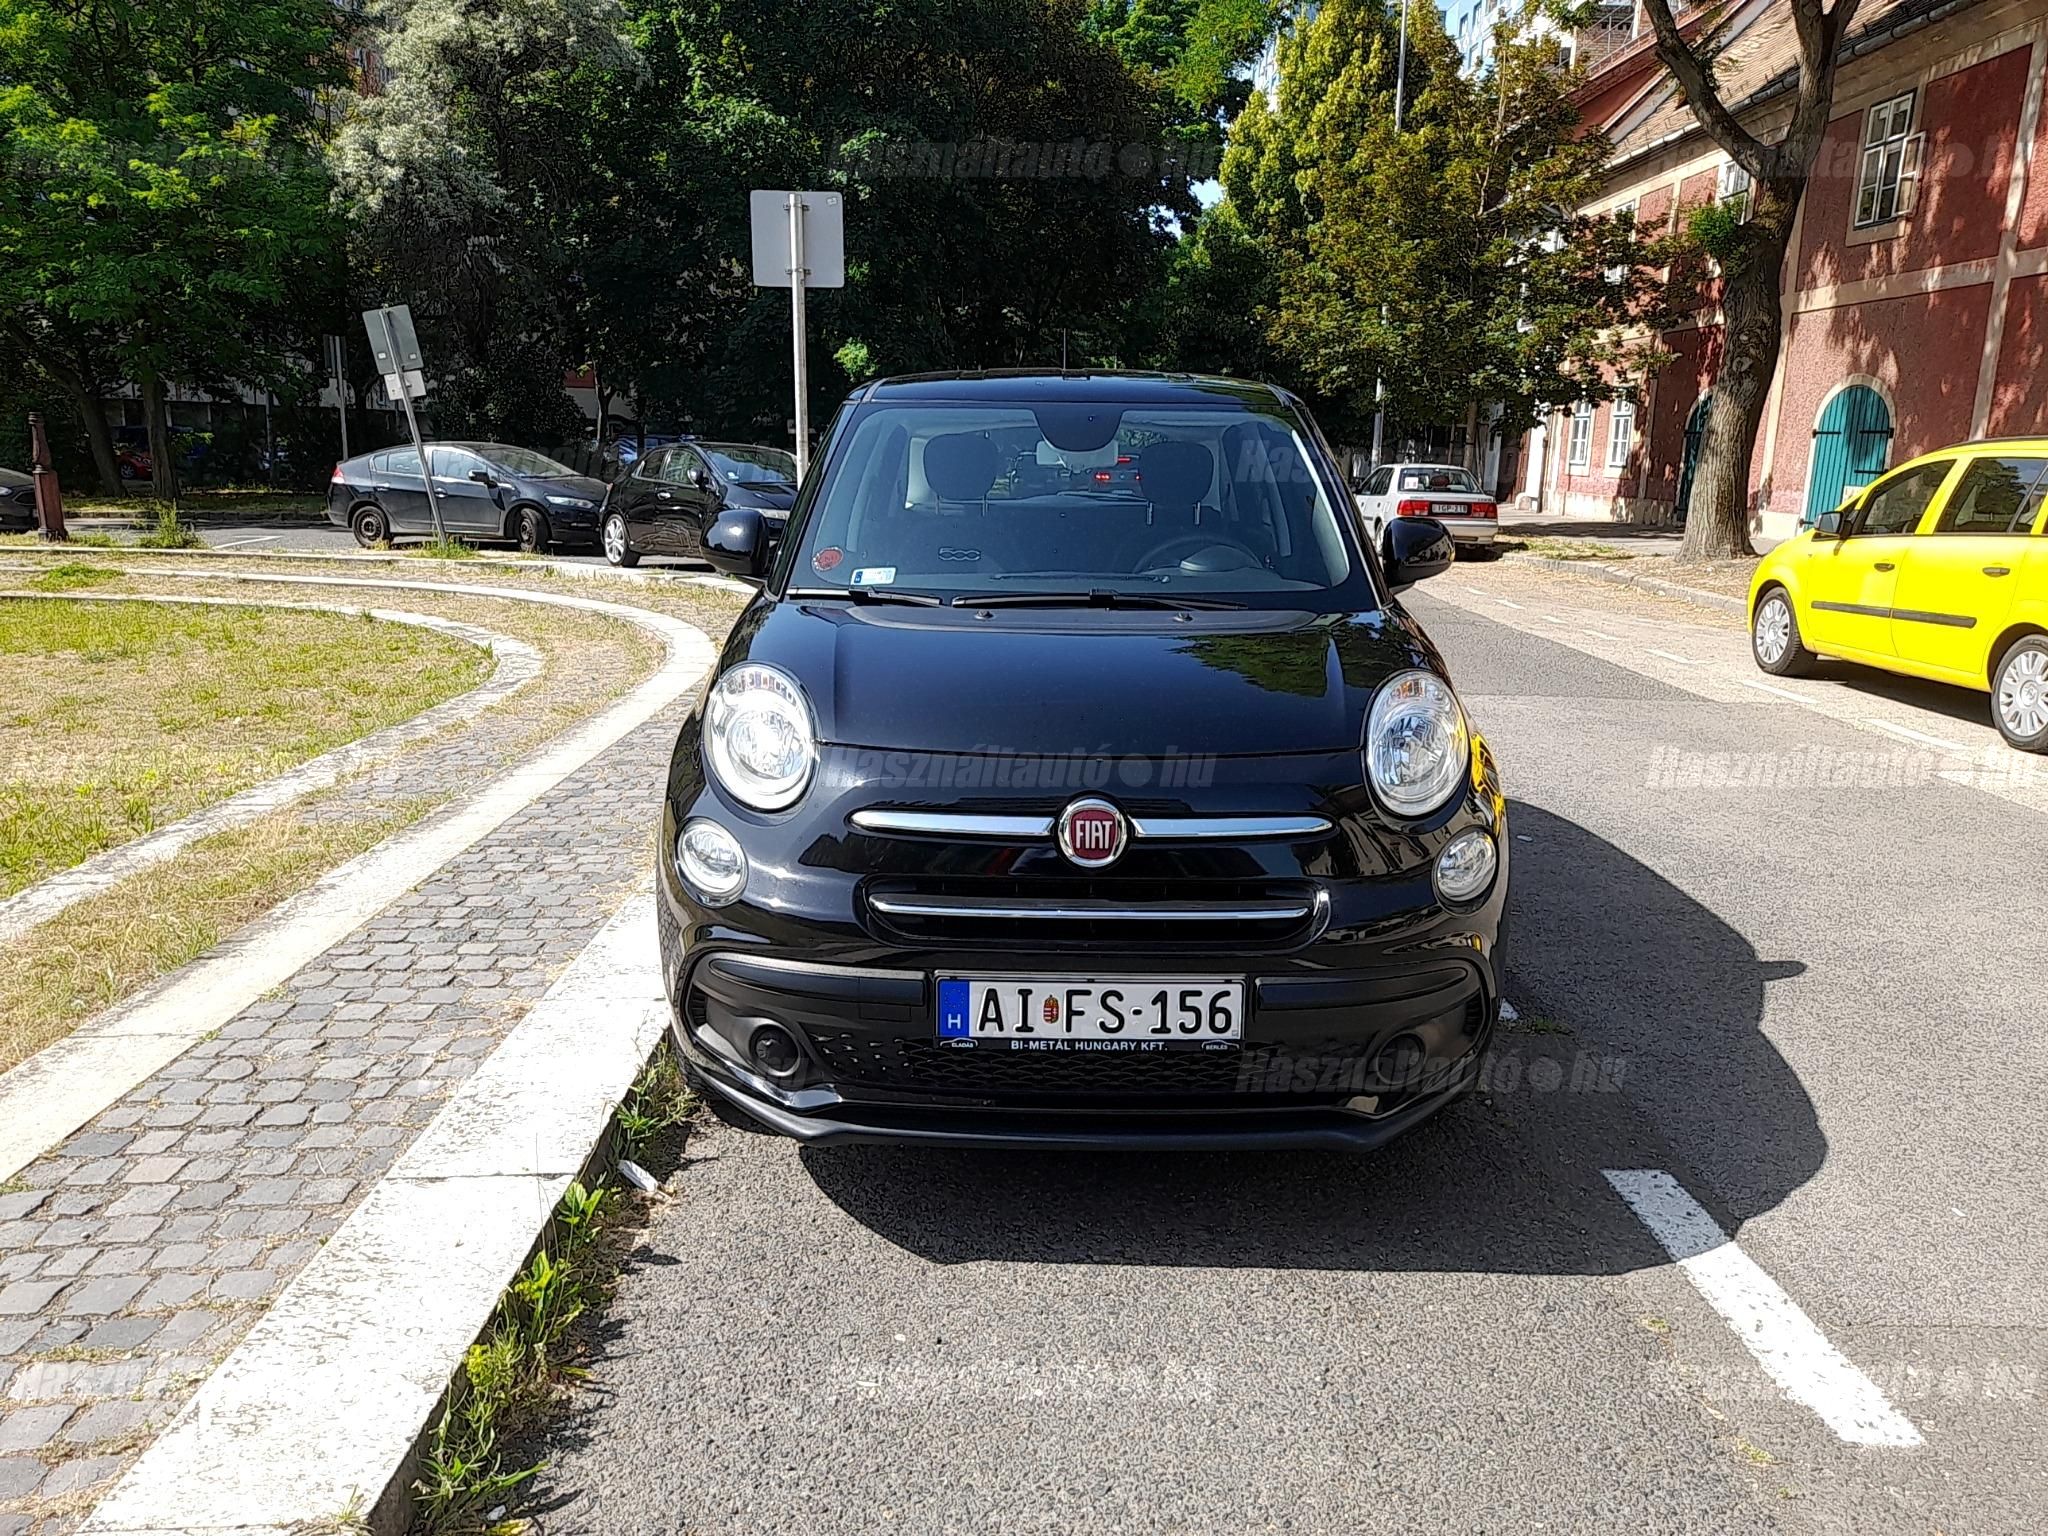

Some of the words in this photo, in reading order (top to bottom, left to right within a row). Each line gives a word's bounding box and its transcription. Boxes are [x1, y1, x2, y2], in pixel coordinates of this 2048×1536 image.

[938, 547, 981, 561] 500
[1075, 820, 1113, 849] FIAT
[1063, 989, 1232, 1034] FS-156
[947, 1013, 961, 1029] H
[1011, 1038, 1070, 1050] BI-METÁL
[1075, 1041, 1137, 1051] HUNGARY
[1141, 1041, 1168, 1051] KFT.
